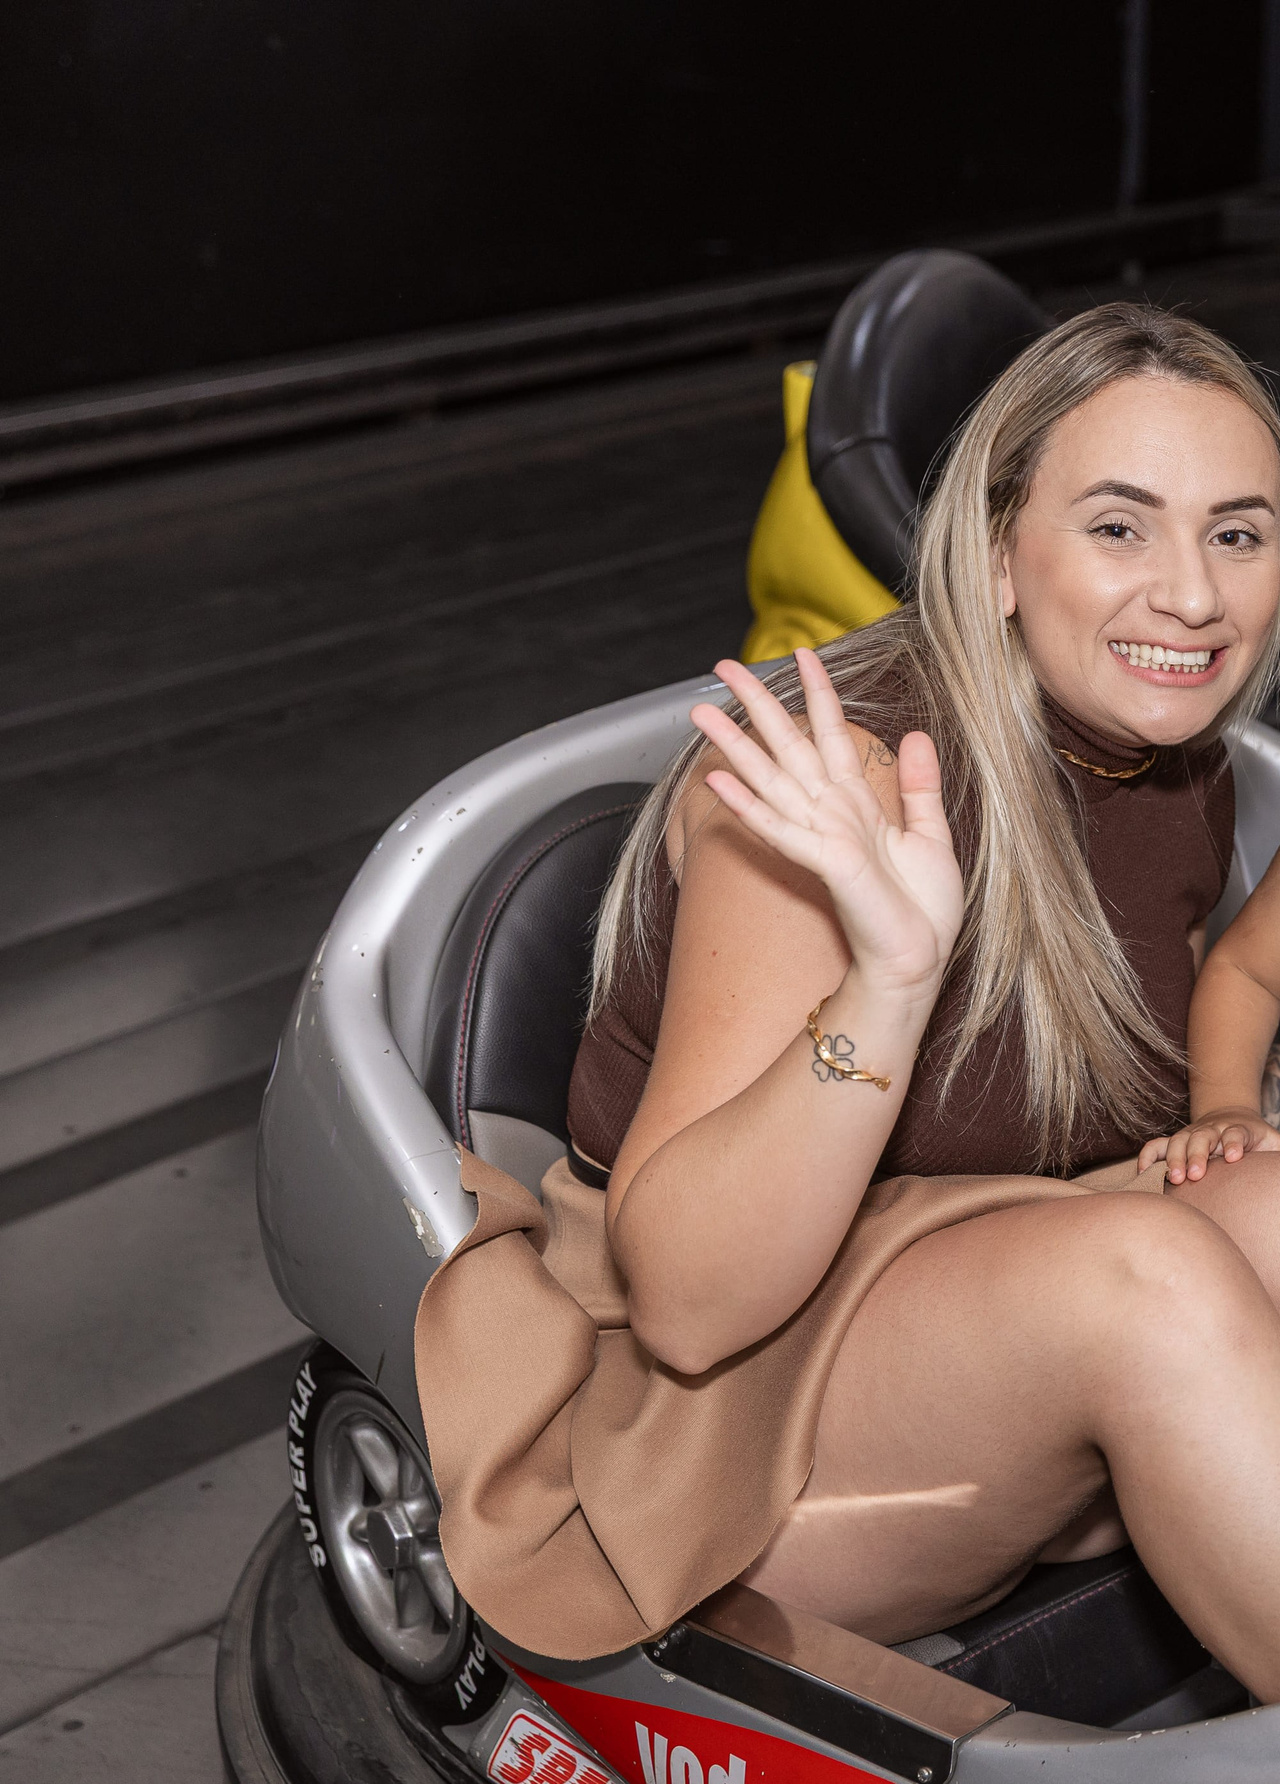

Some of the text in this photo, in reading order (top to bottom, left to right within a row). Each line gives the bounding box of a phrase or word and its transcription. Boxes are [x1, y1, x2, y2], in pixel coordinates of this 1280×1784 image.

[288, 1361, 327, 1568] SUPER PLAY
[454, 1631, 486, 1711] PLAY
